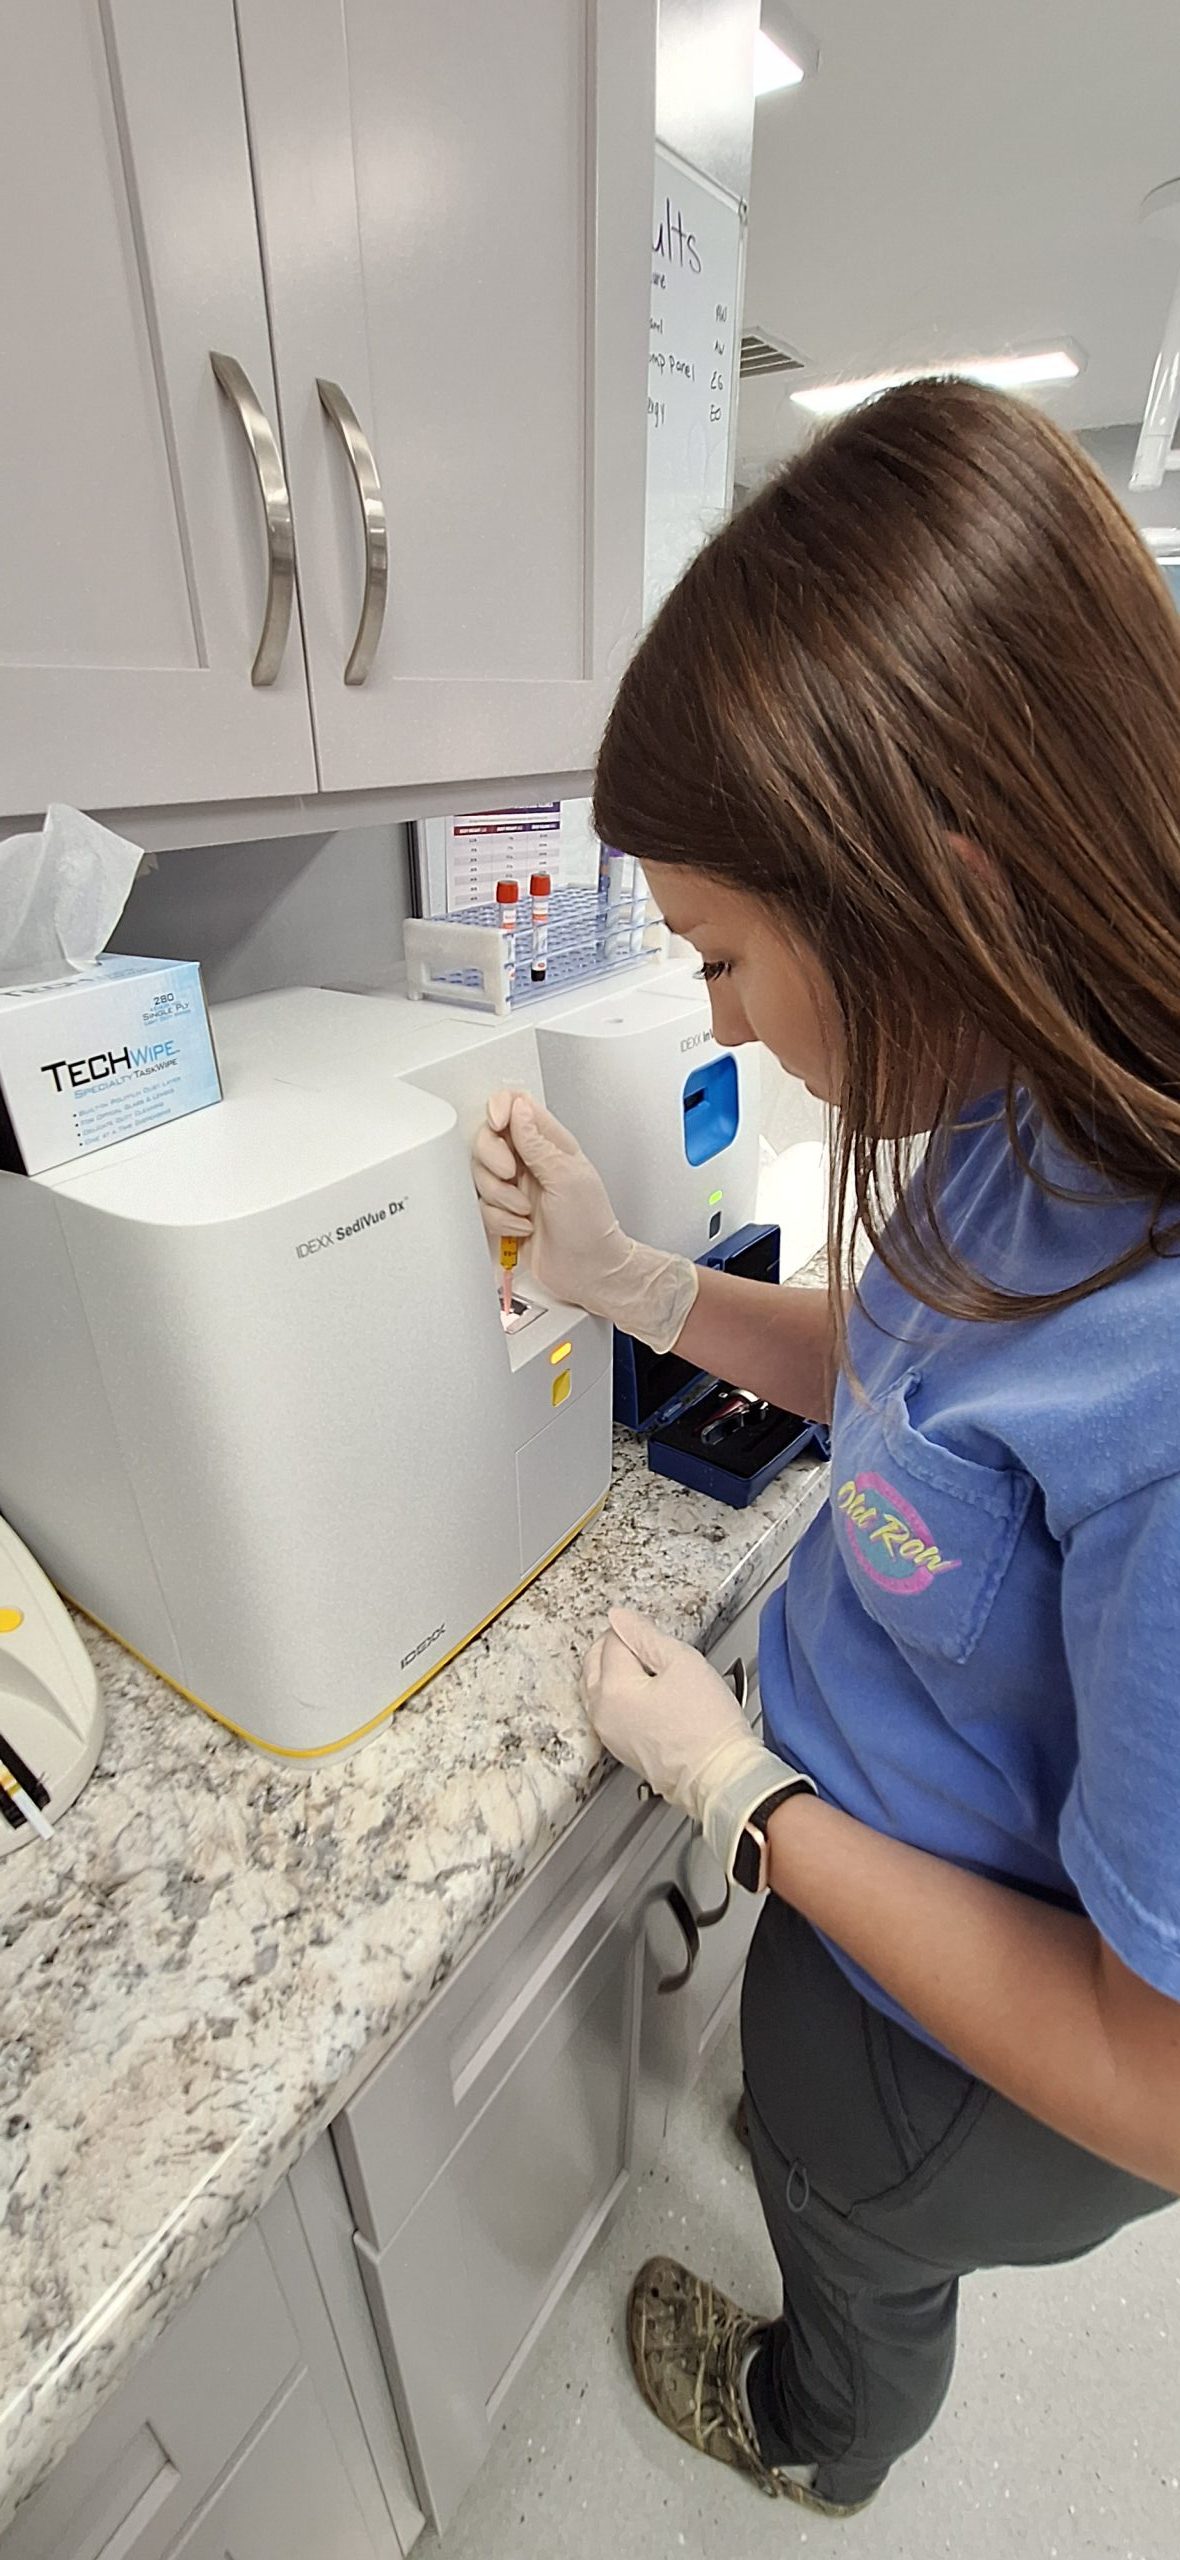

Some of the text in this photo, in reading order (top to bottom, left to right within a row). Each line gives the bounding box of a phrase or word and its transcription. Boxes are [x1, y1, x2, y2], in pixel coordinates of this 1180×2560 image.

[153, 993, 174, 1005] 280
[295, 1200, 406, 1259] IDEXX SediVue Dx
[401, 1622, 446, 1670] IDEXX
